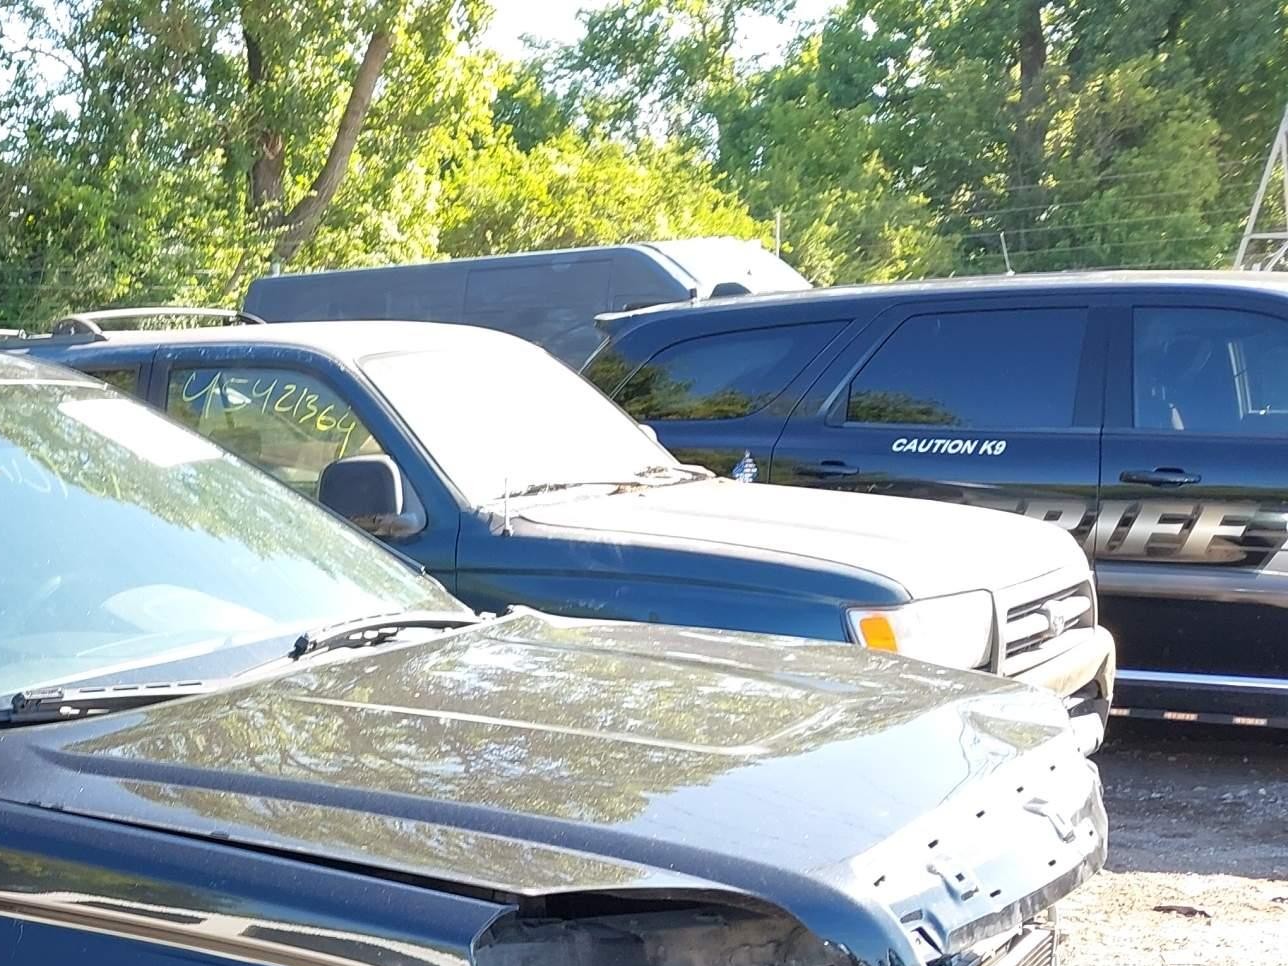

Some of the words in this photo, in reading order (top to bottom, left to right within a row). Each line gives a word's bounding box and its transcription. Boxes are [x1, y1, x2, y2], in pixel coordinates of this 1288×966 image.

[181, 371, 357, 459] 45421364
[892, 438, 979, 455] CAUTION
[978, 440, 1007, 456] K9
[968, 500, 1259, 556] RIFF
